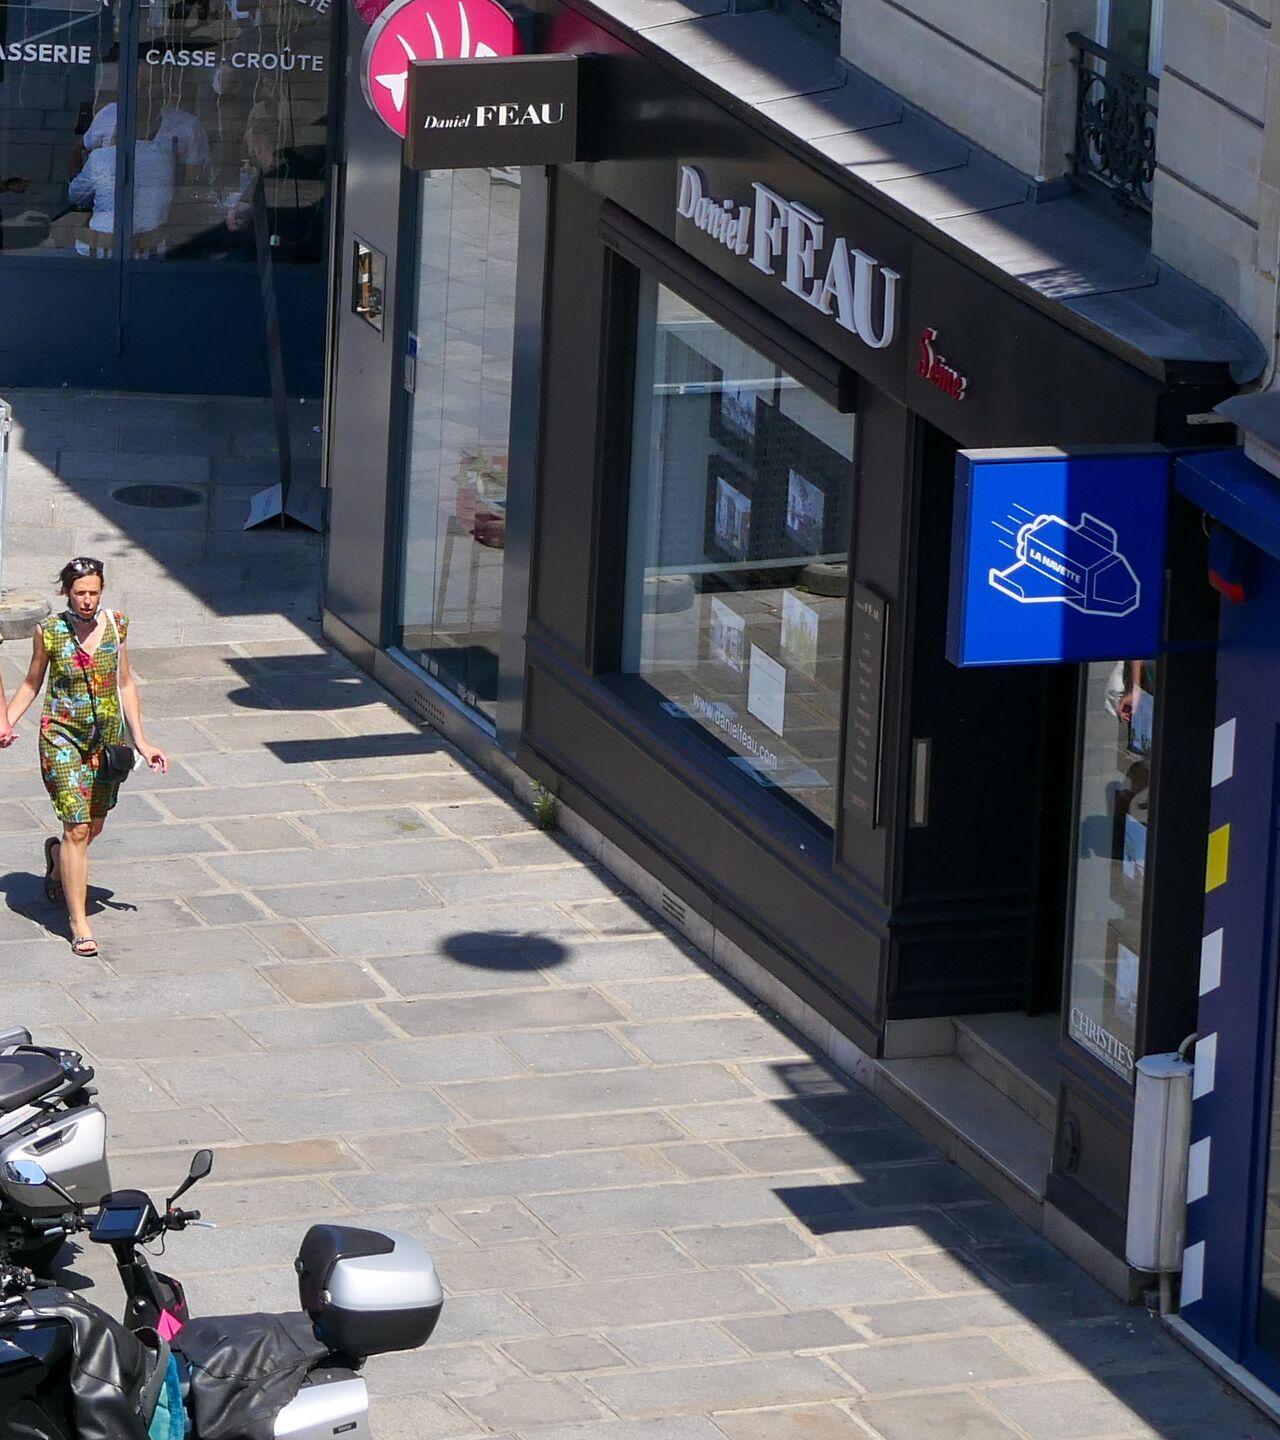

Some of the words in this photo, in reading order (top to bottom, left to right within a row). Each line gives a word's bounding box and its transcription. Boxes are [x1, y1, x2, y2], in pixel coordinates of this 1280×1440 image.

[424, 114, 470, 130] Daniel
[676, 165, 751, 255] Daniel
[1029, 548, 1042, 562] LA
[1042, 555, 1081, 583] NAVETTE
[692, 691, 778, 770] www.danielfeau.com
